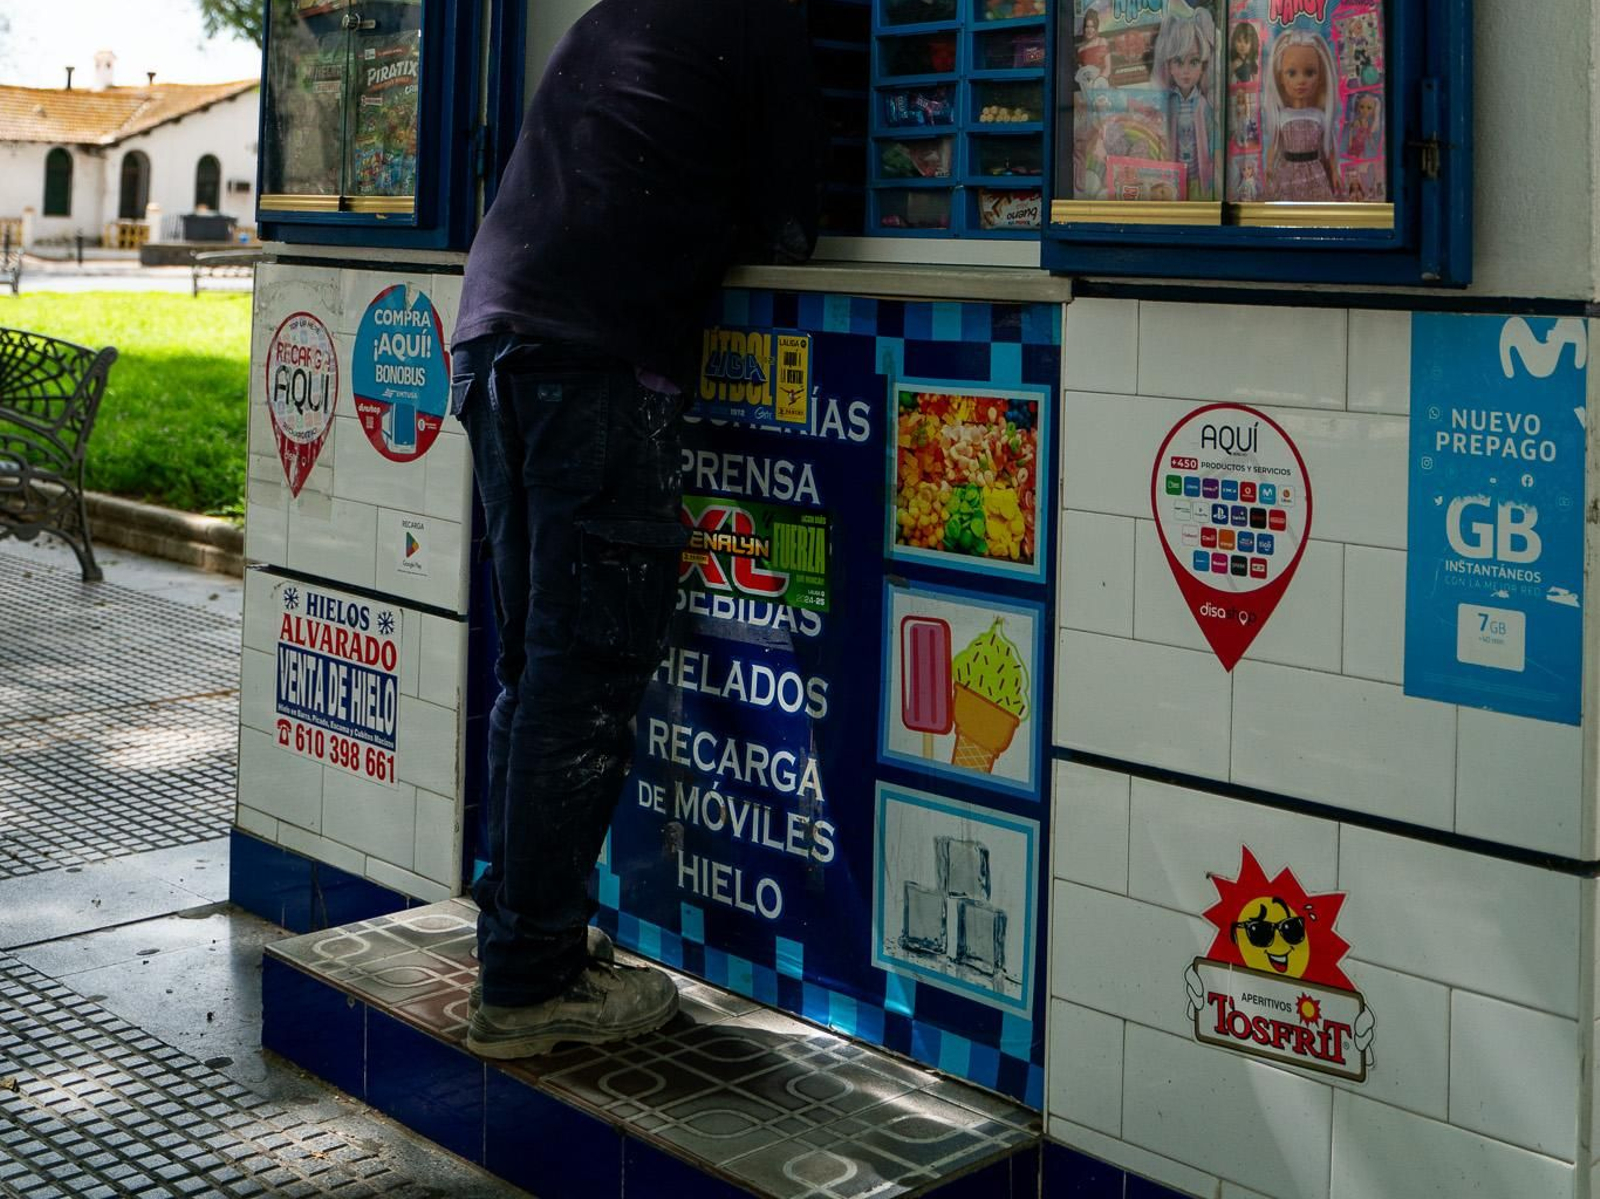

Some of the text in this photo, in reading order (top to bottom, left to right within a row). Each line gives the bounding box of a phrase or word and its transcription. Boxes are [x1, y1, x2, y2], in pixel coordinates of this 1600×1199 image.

[366, 60, 419, 87] PIRATIX
[374, 308, 431, 328] COMPRA
[374, 330, 432, 362] ¡AQUÍ!
[375, 364, 426, 386] BONOBUS
[1201, 421, 1259, 455] AQUÍ
[1451, 408, 1541, 436] NUEVO
[1435, 431, 1557, 462] PREPAGO
[681, 448, 820, 505] PRENSA
[1171, 458, 1197, 469] +450
[1201, 461, 1246, 472] PRODUCTOS
[1253, 466, 1291, 476] SERVICIOS
[402, 520, 424, 530] RECARGA
[1446, 495, 1542, 564] GB
[689, 522, 826, 575] ENALYN FUERZA
[1444, 576, 1466, 587] CON
[1469, 578, 1481, 587] LA
[1521, 584, 1541, 597] RED
[1445, 560, 1542, 584] INSTANTÁNEOS
[306, 591, 370, 632] HIELOS
[279, 612, 397, 672] ALVARADO
[278, 646, 396, 737] VENTA DE HIELO
[651, 646, 829, 720] HELADOS
[295, 722, 395, 784] 610 398 661
[648, 716, 826, 803] RECARGA
[637, 779, 836, 864] DE MÓVILES
[678, 849, 783, 921] HIELO
[1241, 991, 1293, 1014] APERITIVOS
